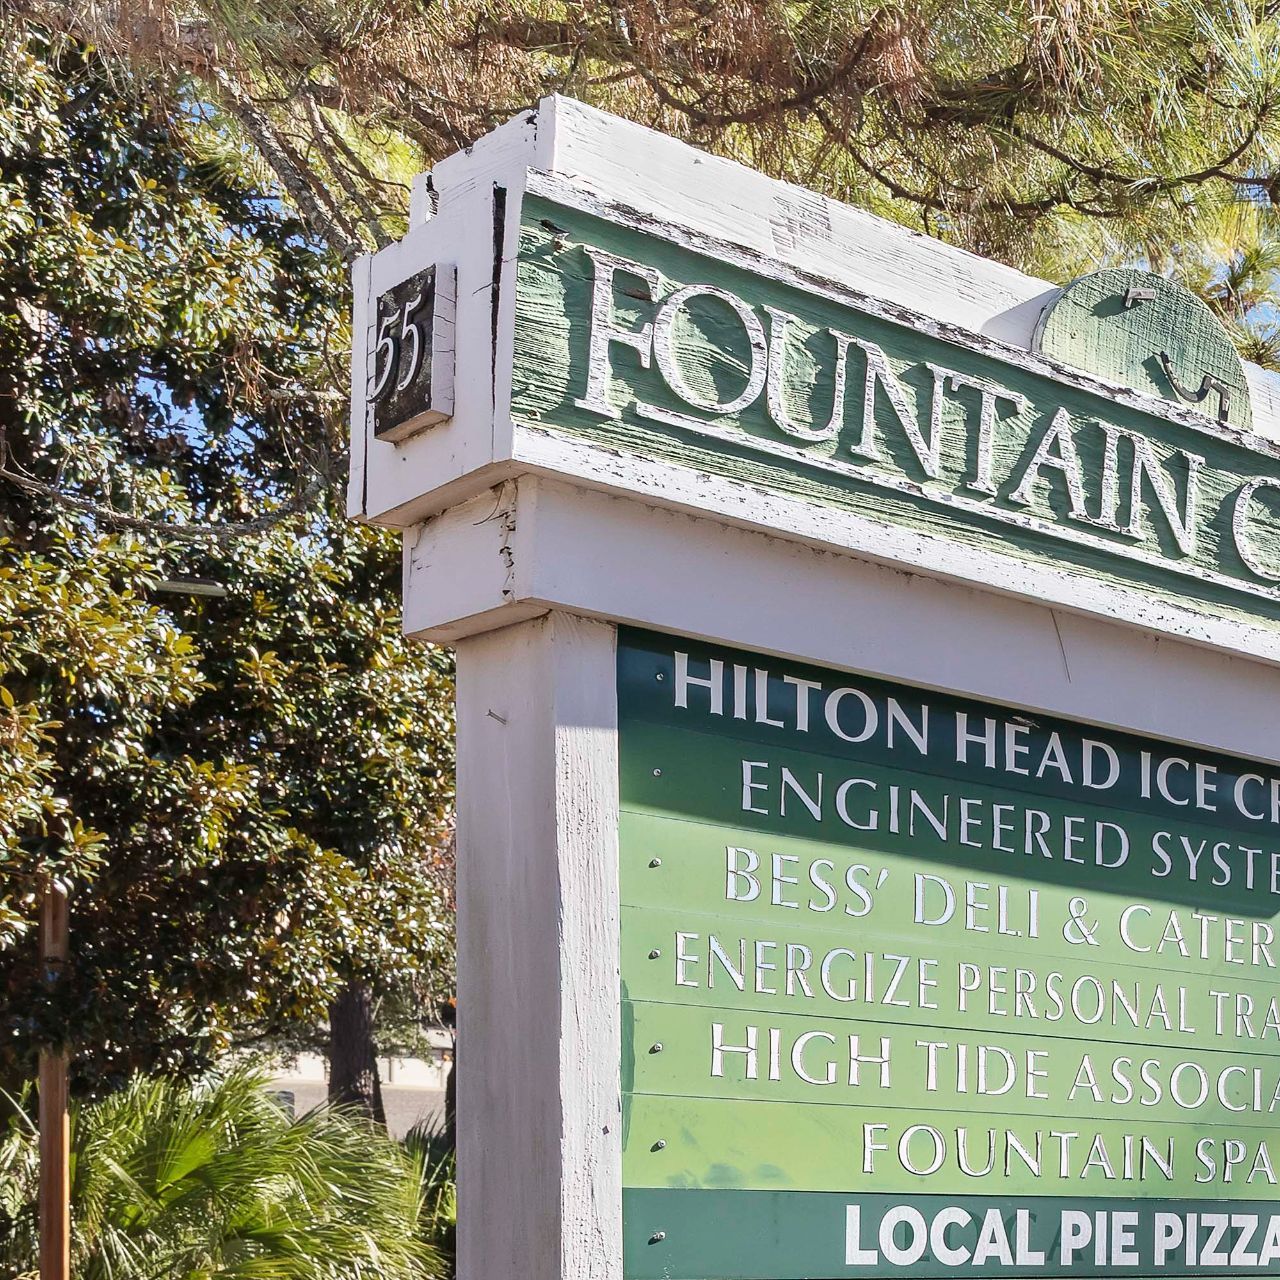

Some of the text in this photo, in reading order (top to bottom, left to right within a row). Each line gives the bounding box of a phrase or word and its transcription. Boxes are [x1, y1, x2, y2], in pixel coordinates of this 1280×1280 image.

[366, 294, 421, 401] 55
[574, 246, 1203, 556] FOUNTAIN
[674, 651, 929, 755] HILTON
[956, 712, 1121, 789] HEAD
[1142, 752, 1217, 812] ICE
[741, 759, 1130, 869] ENGINEERED
[726, 845, 889, 917] BESS'
[914, 873, 1040, 940] DELI
[1064, 896, 1099, 946] &
[675, 931, 939, 1010] ENERGIZE
[958, 961, 1197, 1034] PERSONAL
[711, 1023, 892, 1089] HIGH
[915, 1039, 1049, 1099] TIDE
[862, 1123, 1278, 1185] FOUNTAIN SPA
[845, 1204, 1044, 1266] LOCAL
[1060, 1210, 1140, 1266] PIE
